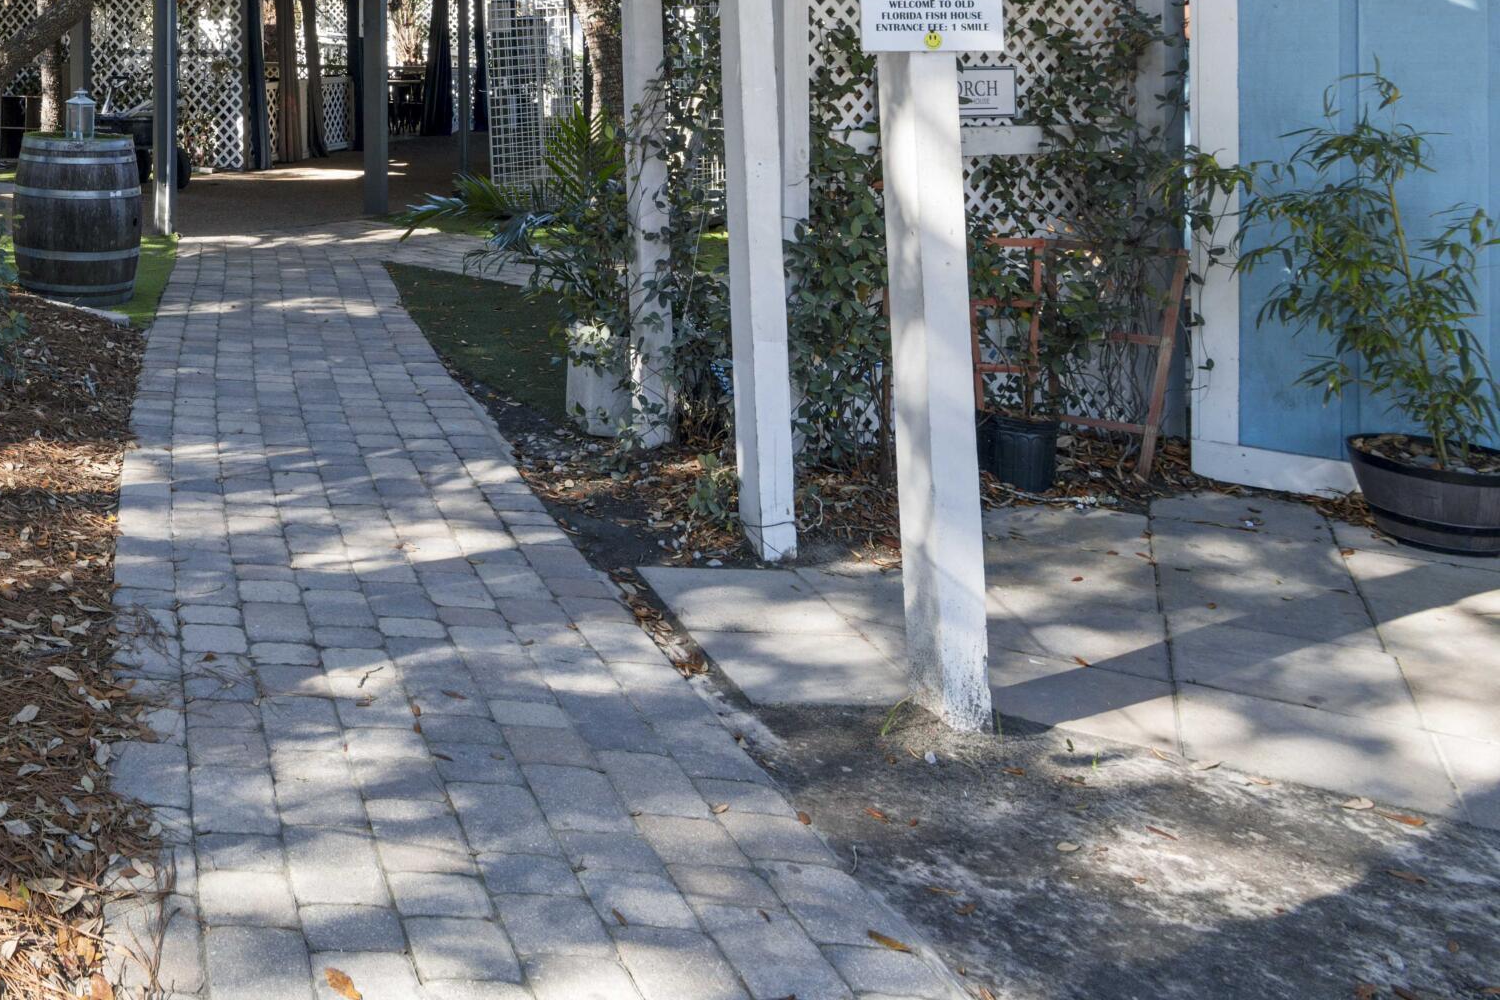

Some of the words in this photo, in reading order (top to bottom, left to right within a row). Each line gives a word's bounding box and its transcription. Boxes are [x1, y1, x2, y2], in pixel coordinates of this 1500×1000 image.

[889, 0, 936, 9] WELCOME
[940, 0, 952, 8] TO
[955, 0, 975, 8] OLD
[881, 11, 923, 20] FLORIDA
[925, 11, 947, 20] FISH
[950, 11, 983, 20] HOUSE
[876, 23, 925, 32] ENTRANCE
[928, 23, 948, 32] FEE:
[960, 23, 989, 32] SMILE
